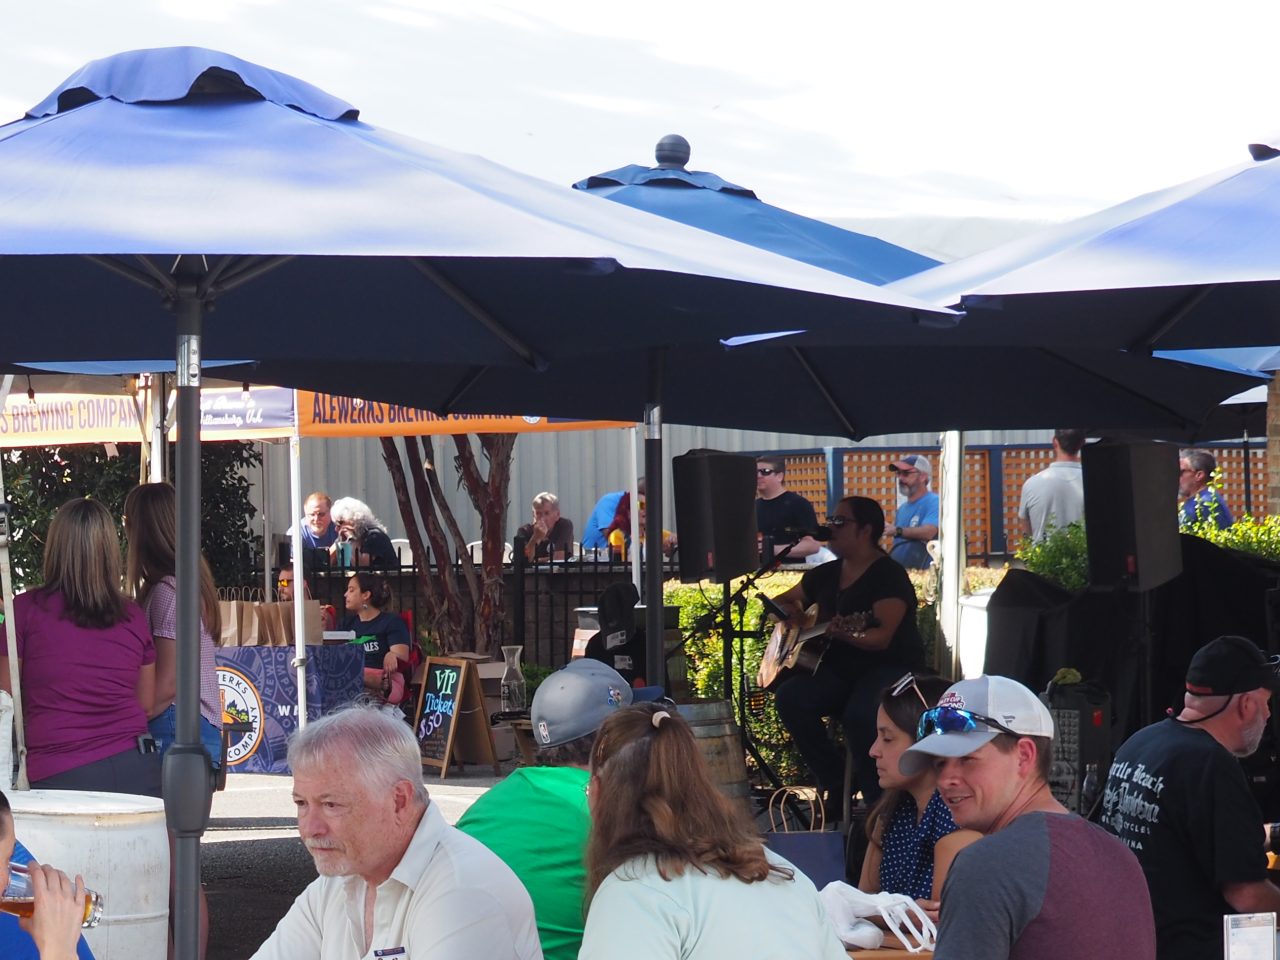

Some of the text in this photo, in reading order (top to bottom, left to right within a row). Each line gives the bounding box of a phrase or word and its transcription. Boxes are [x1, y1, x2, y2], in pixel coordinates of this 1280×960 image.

[13, 402, 74, 433] BREWING
[222, 673, 249, 695] ERKS
[435, 669, 457, 694] VIP
[424, 692, 456, 717] Tickets
[419, 713, 443, 740] $50
